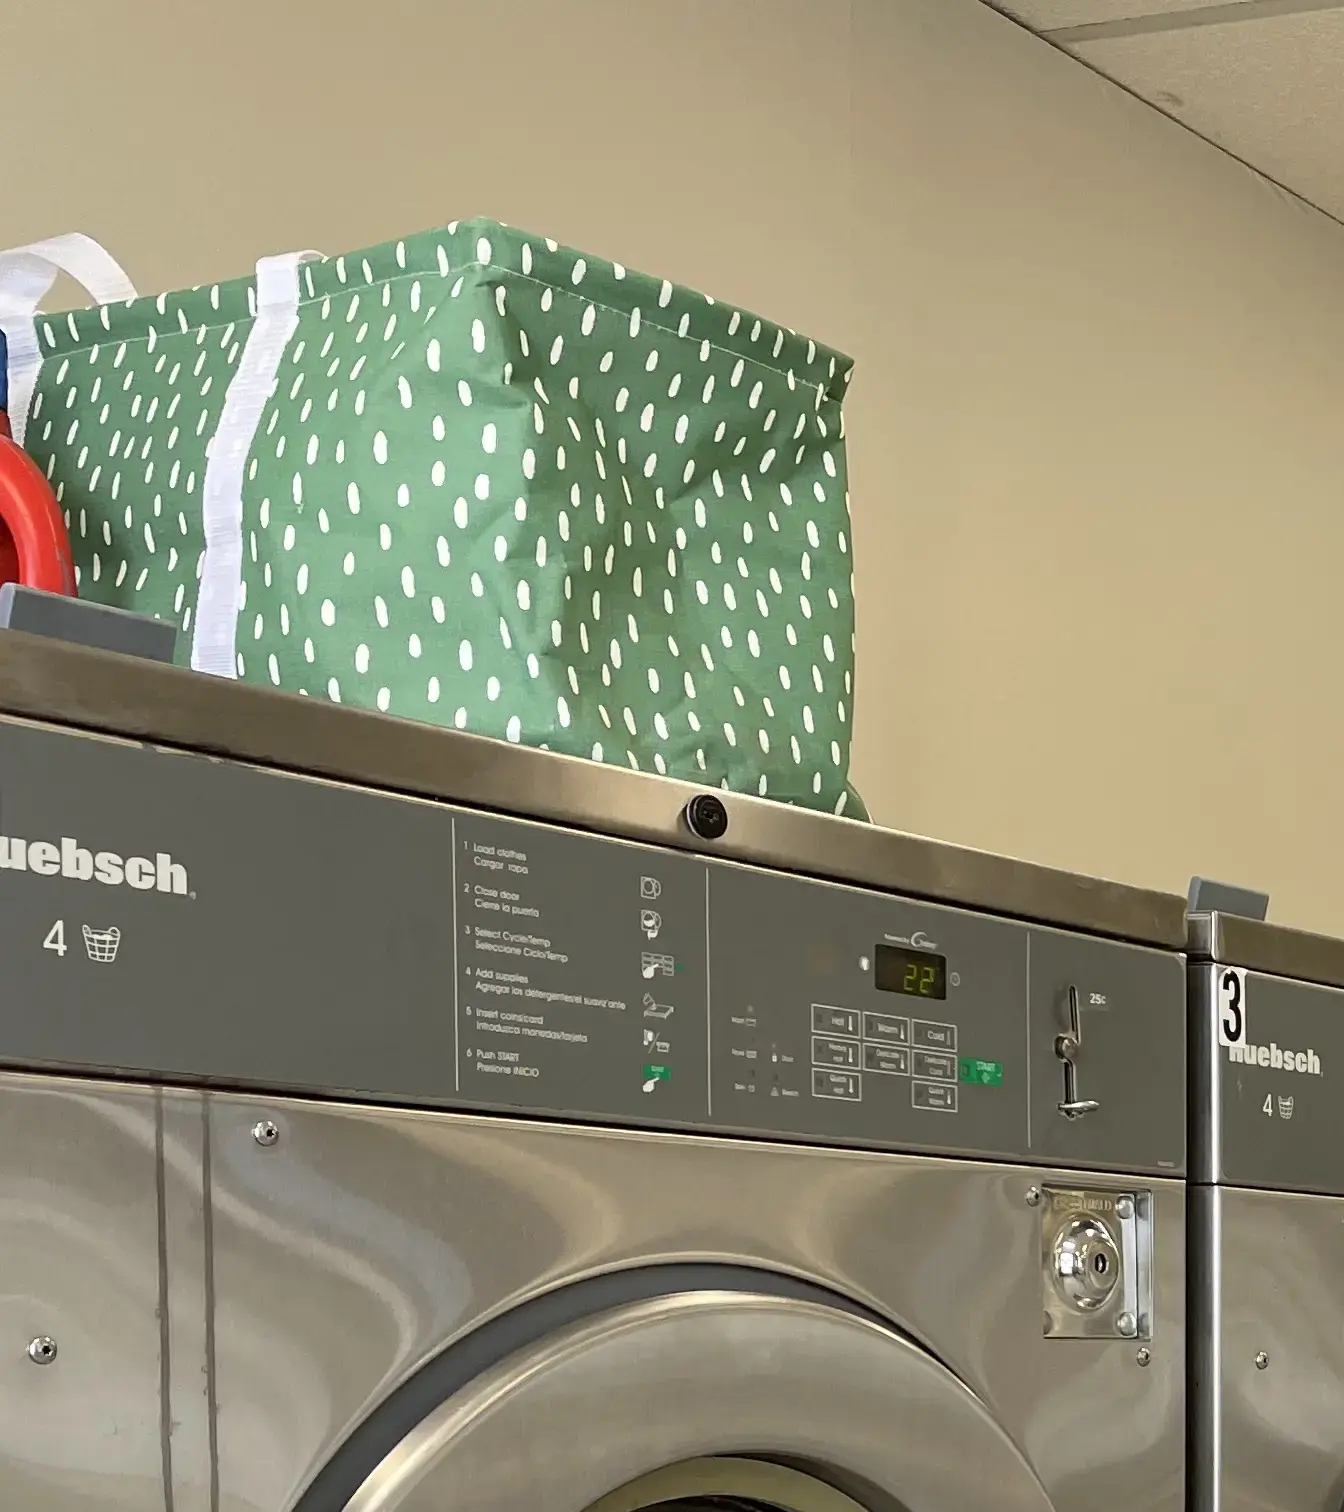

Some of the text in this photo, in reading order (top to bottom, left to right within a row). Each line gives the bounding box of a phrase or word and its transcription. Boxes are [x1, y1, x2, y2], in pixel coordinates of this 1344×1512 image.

[0, 835, 187, 895] uebsch
[464, 883, 470, 893] 2
[43, 920, 67, 956] 4
[465, 926, 470, 934] 3
[466, 967, 471, 975] 4
[903, 964, 934, 993] 22
[1223, 972, 1242, 1042] 3
[467, 1049, 472, 1057] 6
[1262, 1093, 1273, 1117] 4
